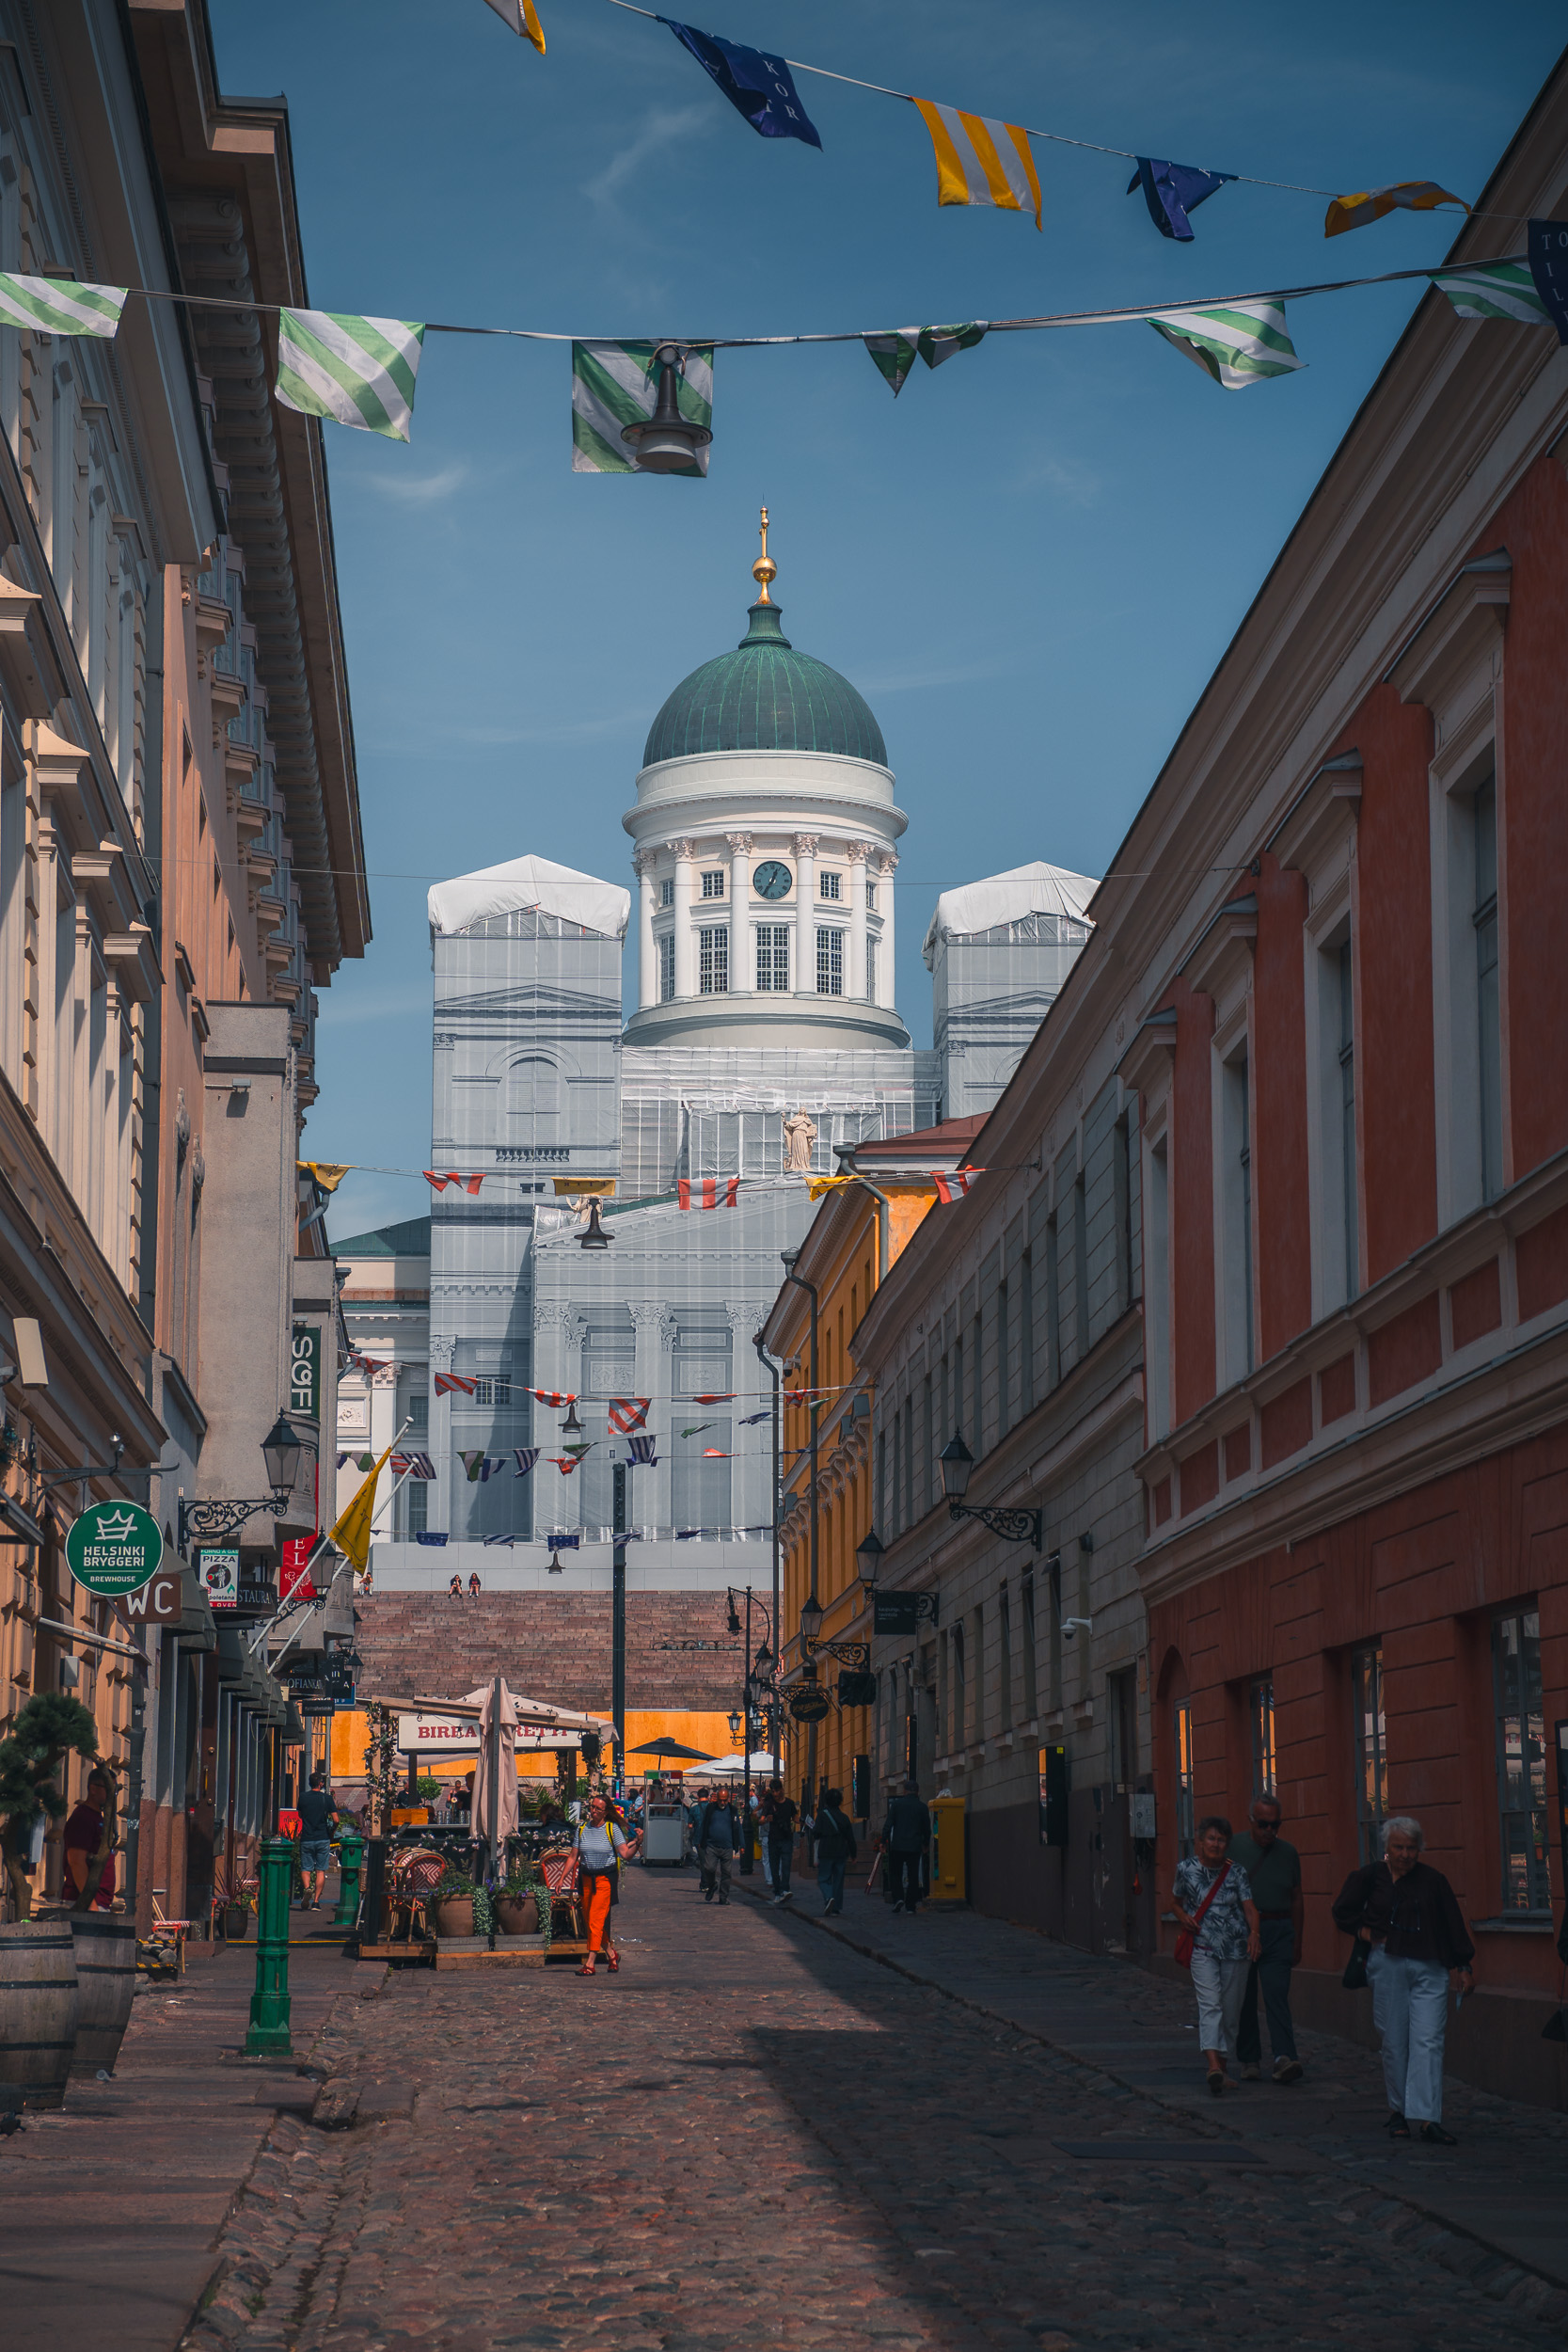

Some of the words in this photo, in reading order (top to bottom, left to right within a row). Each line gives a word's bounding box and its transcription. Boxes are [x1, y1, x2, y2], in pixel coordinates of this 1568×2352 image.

[84, 1546, 145, 1556] HELSINKI
[84, 1557, 145, 1566] BRYGGERI
[126, 1581, 174, 1615] WC
